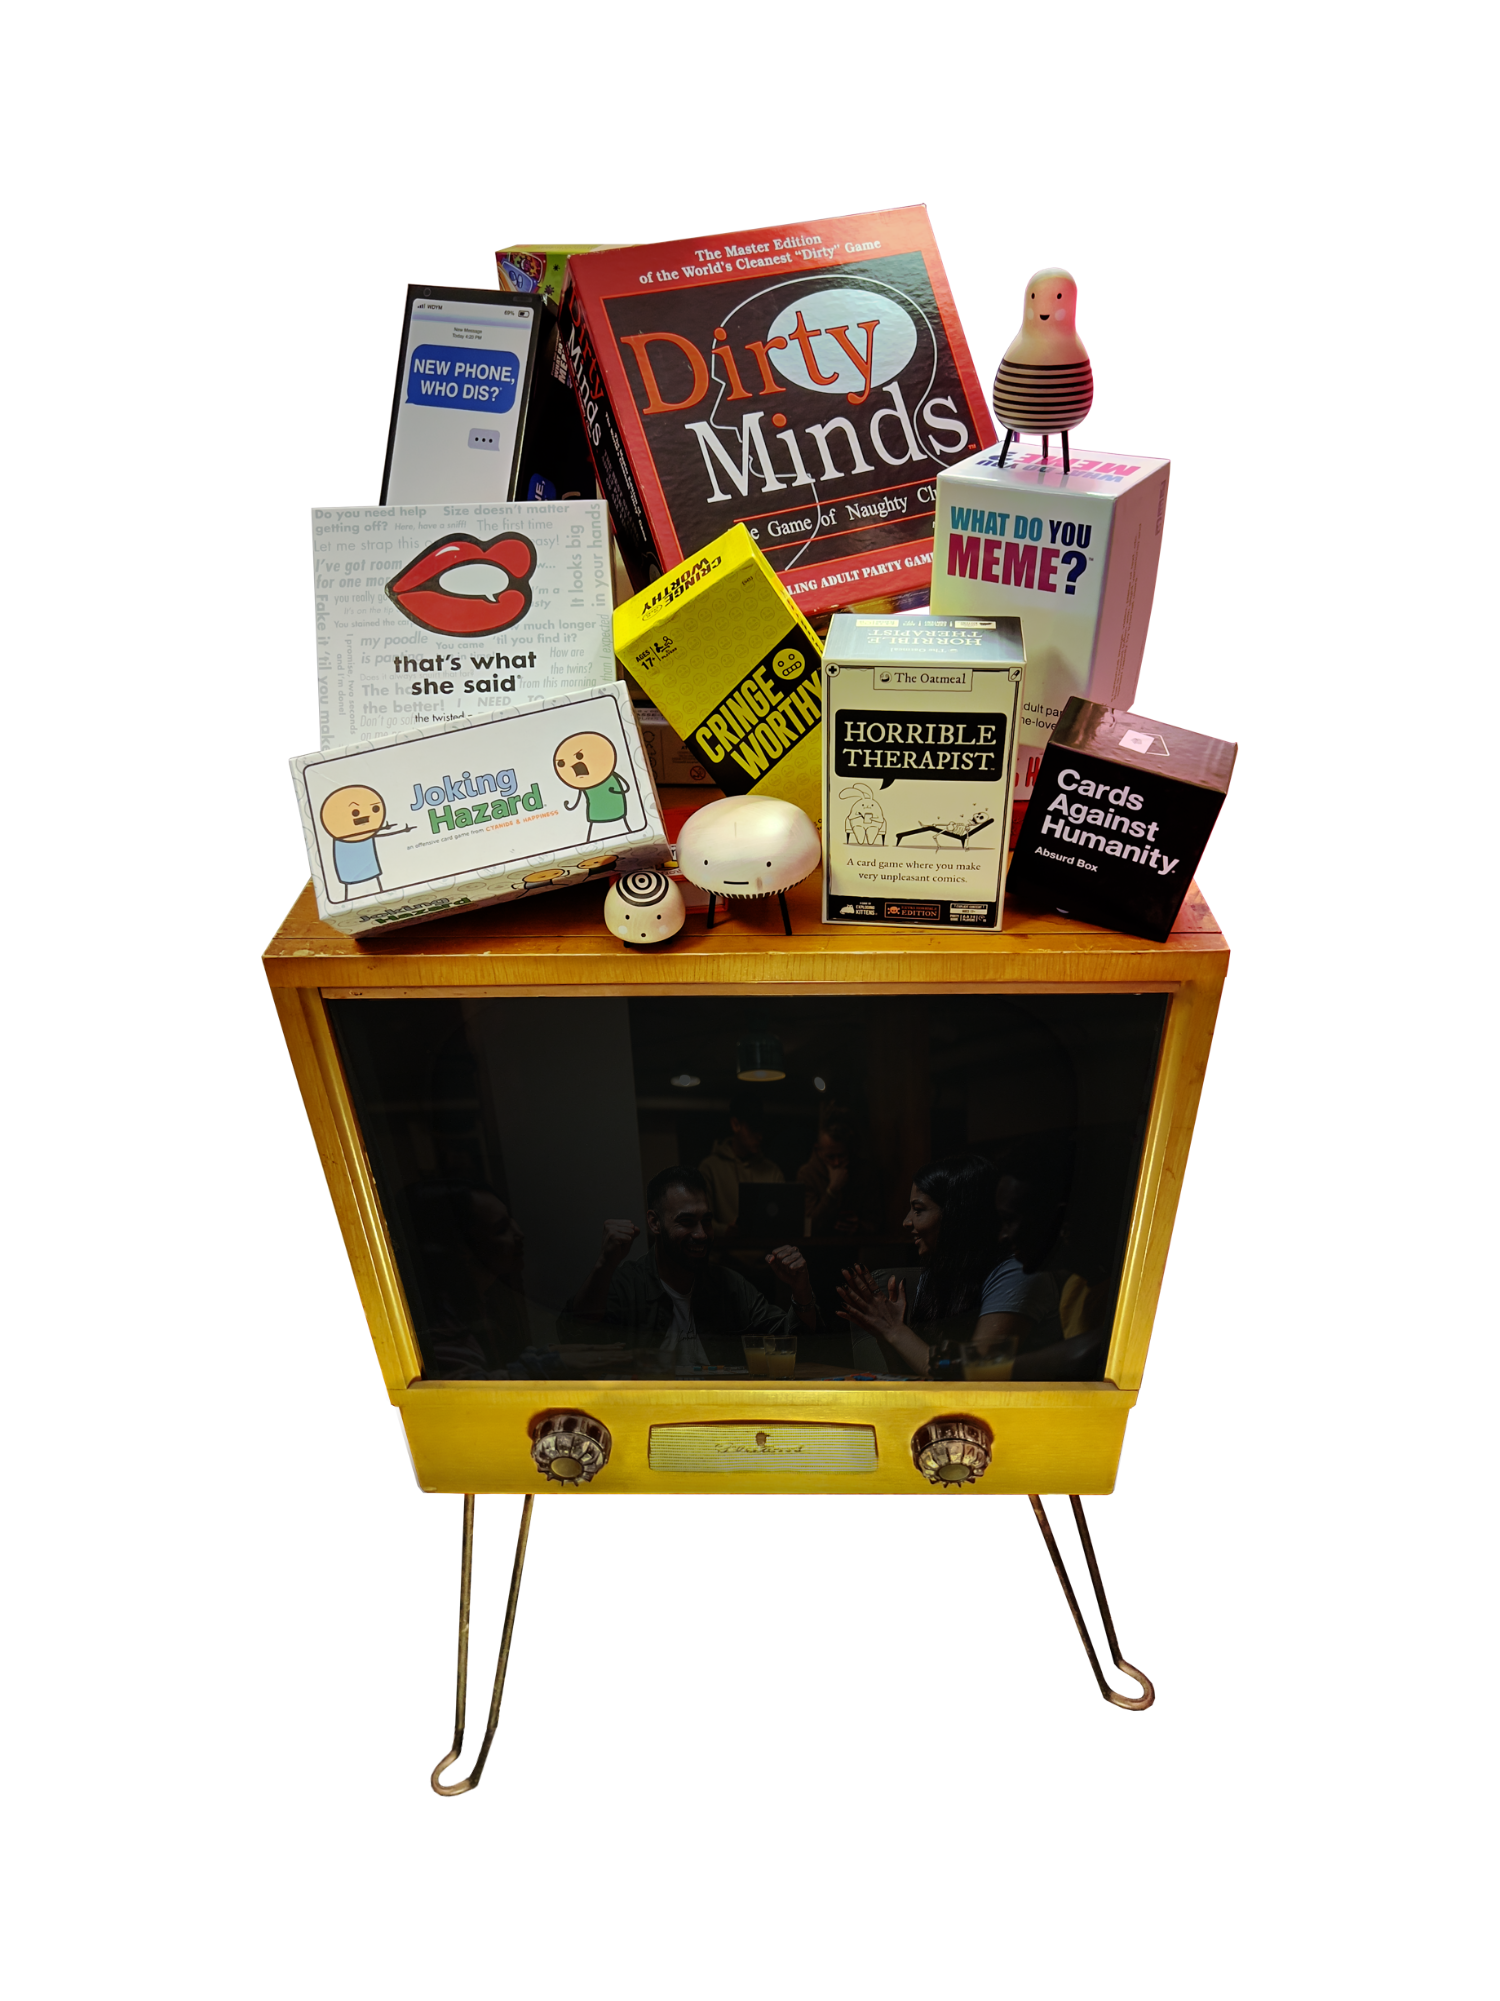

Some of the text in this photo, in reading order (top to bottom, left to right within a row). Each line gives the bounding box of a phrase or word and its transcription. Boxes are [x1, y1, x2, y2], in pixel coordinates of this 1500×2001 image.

[694, 235, 822, 262] The Master Edition
[639, 272, 657, 284] of
[660, 268, 679, 281] the
[682, 260, 733, 278] World's
[736, 252, 791, 270] Cleanest
[844, 239, 882, 252] Game
[568, 288, 604, 400] Dirty
[414, 359, 515, 384] NEW PHONE,
[620, 310, 880, 415] Dirty
[421, 380, 500, 402] WHO DIS?
[567, 323, 601, 446] Minds
[684, 381, 970, 503] Minds
[315, 506, 426, 521] Do you need help
[444, 504, 570, 516] Size doesn't matter
[768, 518, 813, 538] Game
[821, 509, 837, 528] of
[845, 494, 908, 522] Naughty
[316, 521, 388, 536] getting off?
[418, 522, 437, 530] have
[447, 520, 466, 528] sniff!
[476, 518, 553, 531] The first time
[950, 506, 1092, 548] WHAT DO YOU
[314, 540, 332, 552] Let
[336, 542, 356, 550] me
[361, 540, 393, 553] strap
[398, 537, 420, 549] this
[585, 504, 609, 606] in your hands
[315, 559, 402, 576] I've got room
[566, 524, 584, 608] It looks big
[820, 560, 902, 588] ADULT PARTY
[947, 533, 1088, 595] MEME?
[316, 574, 362, 589] for one
[642, 557, 710, 616] WORTHY
[664, 556, 722, 607] CRINGE
[334, 592, 376, 606] you really
[316, 594, 330, 631] Fake
[370, 606, 382, 614] the
[384, 606, 394, 616] tip
[334, 620, 348, 628] You
[352, 620, 380, 628] stained
[524, 620, 555, 630] much
[559, 620, 596, 632] longer
[868, 630, 982, 638] THERAPIST
[318, 637, 330, 646] it
[360, 631, 428, 650] my poodle
[436, 642, 454, 650] You
[511, 636, 534, 647] you
[537, 633, 560, 644] find
[564, 633, 578, 643] it?
[596, 614, 613, 682] than expected
[868, 636, 982, 646] HORRIBLE
[336, 654, 344, 671] and
[361, 652, 371, 664] is
[394, 654, 462, 673] that's
[470, 652, 536, 670] what
[550, 647, 584, 658] How are
[636, 650, 652, 662] AGES
[550, 662, 593, 674] the twins?
[641, 656, 656, 671] 17+
[344, 639, 354, 678] promise,
[349, 700, 358, 735] seconds
[411, 678, 454, 696] she
[464, 674, 516, 694] said
[543, 676, 558, 688] this
[561, 678, 597, 688] morning
[894, 672, 966, 684] The Oatmeal
[318, 676, 329, 704] you
[362, 684, 390, 696] The
[363, 700, 444, 714] the better!
[477, 696, 511, 708] NEED
[1024, 702, 1044, 714] dult
[360, 715, 398, 729] Don't go
[415, 712, 430, 723] the
[696, 665, 784, 764] CRINGE
[320, 711, 335, 752] make
[730, 670, 822, 780] WORTHY
[844, 722, 996, 746] HORRIBLE
[361, 732, 372, 742] on
[842, 748, 995, 770] THERAPIST
[410, 768, 518, 812] Joking
[1057, 769, 1144, 810] Cards
[428, 783, 544, 834] Hazard
[1048, 794, 1160, 842] Against
[415, 838, 440, 849] offensive
[441, 834, 454, 843] card
[454, 832, 470, 840] game
[470, 828, 484, 836] from
[486, 820, 514, 832] CYANIDE
[523, 810, 559, 822] HAPPINESS
[846, 858, 981, 872] A card game where you make
[1034, 846, 1098, 872] Absurd Box
[858, 873, 968, 884] very unpleasant comics.
[358, 898, 450, 923] Joking
[375, 897, 472, 924] Hazard
